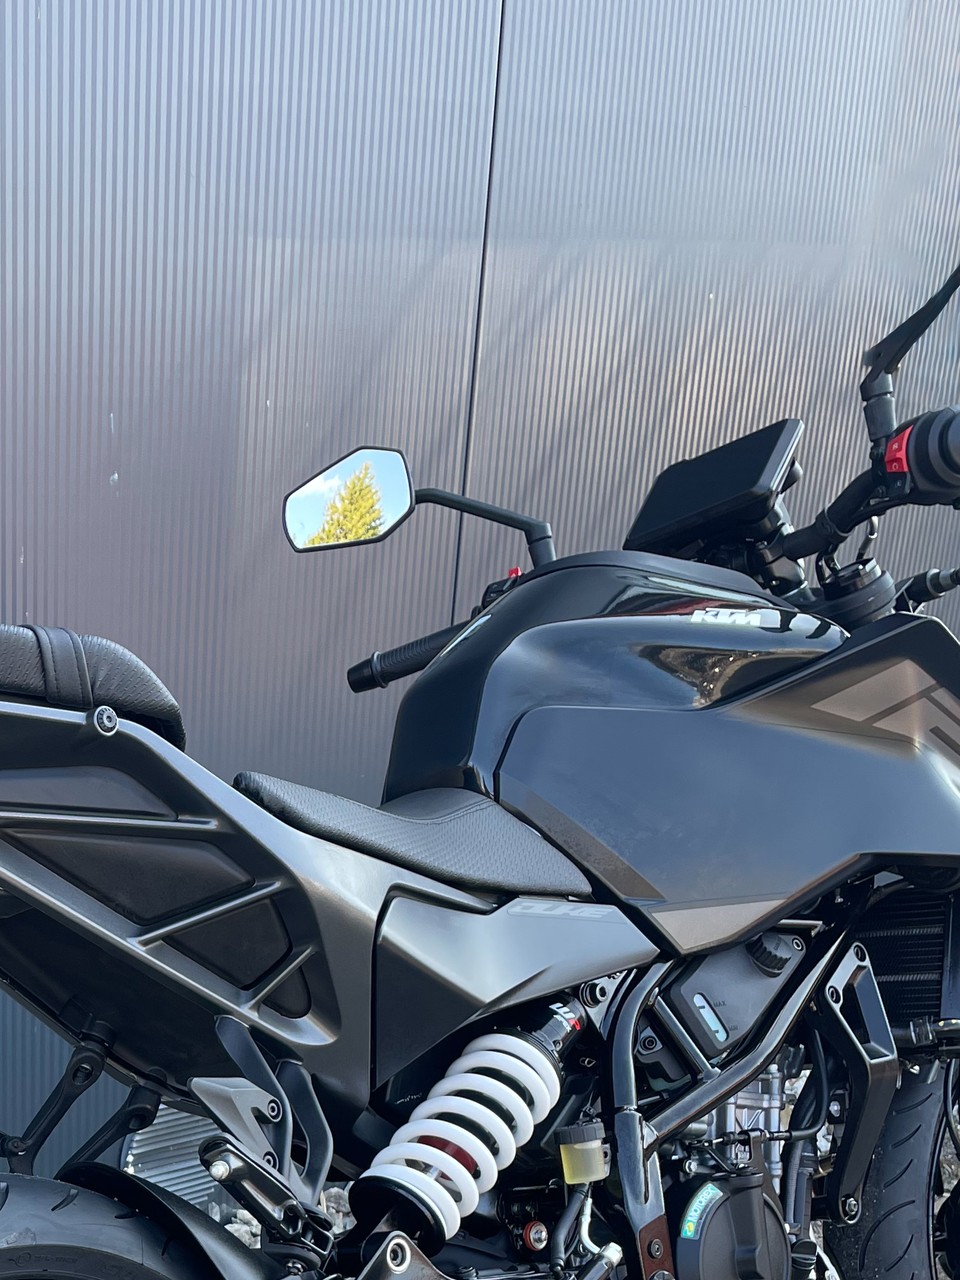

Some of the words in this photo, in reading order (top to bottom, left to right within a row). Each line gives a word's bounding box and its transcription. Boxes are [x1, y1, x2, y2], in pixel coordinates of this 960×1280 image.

[690, 607, 761, 627] KTM
[510, 902, 614, 918] DUKE
[686, 1185, 719, 1222] MOTOREX
